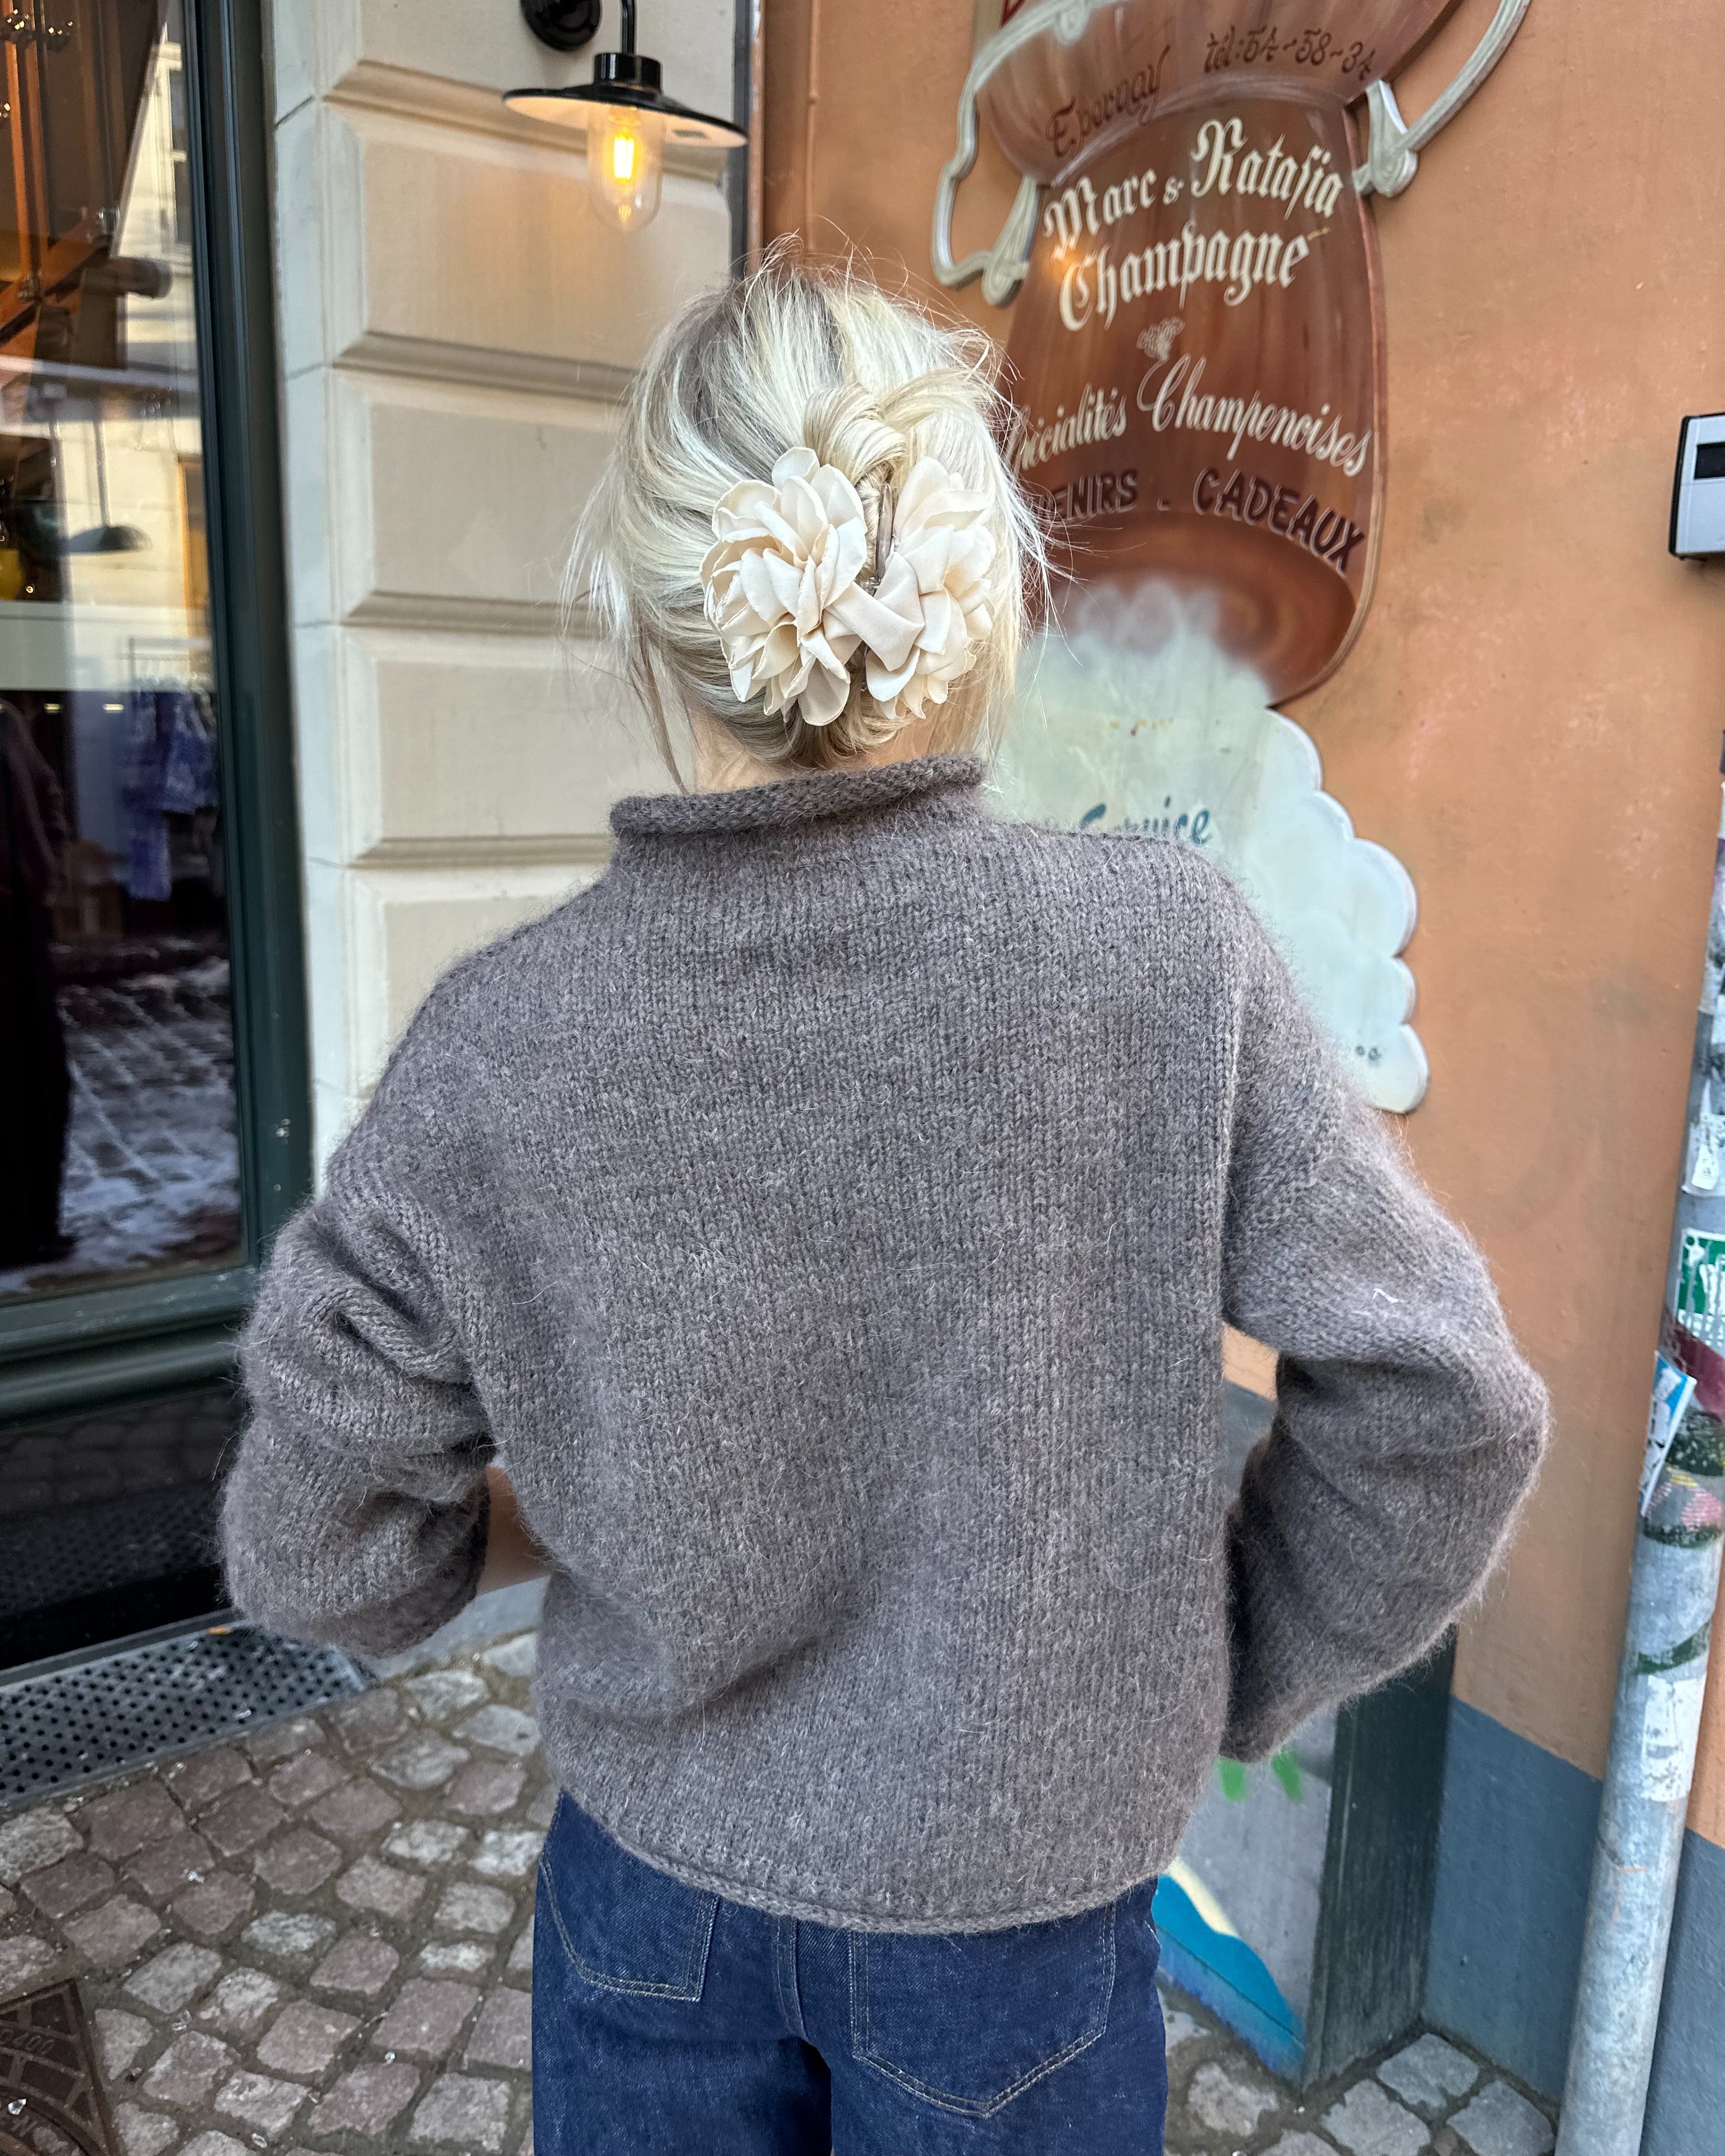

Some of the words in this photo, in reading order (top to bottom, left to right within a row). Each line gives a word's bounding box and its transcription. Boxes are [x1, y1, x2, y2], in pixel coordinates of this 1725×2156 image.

[1044, 169, 1157, 260] Marc
[1191, 117, 1343, 220] Ratafia
[1059, 221, 1310, 331] Champagne
[1137, 354, 1371, 477] Champenoises
[1193, 467, 1364, 578] CADEAUX
